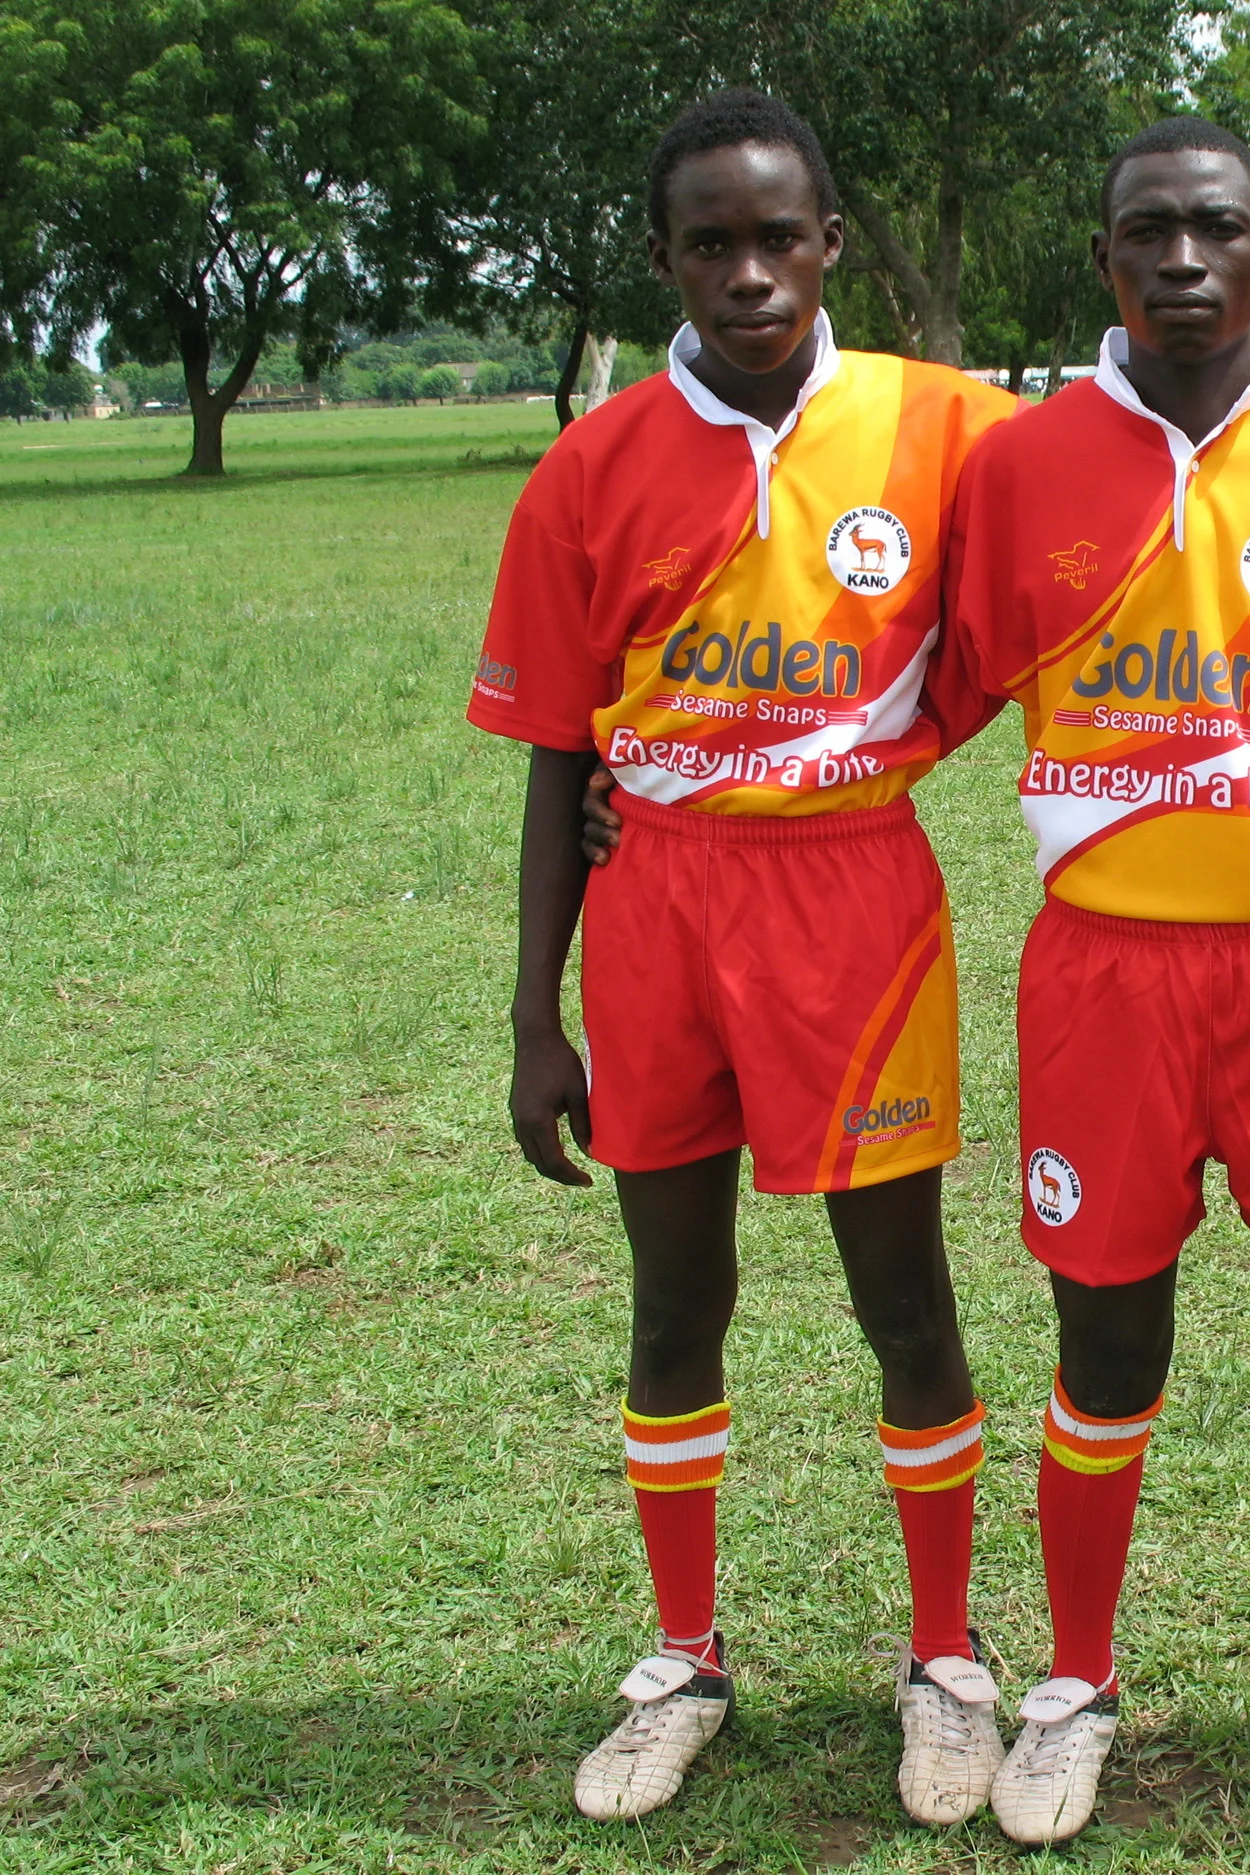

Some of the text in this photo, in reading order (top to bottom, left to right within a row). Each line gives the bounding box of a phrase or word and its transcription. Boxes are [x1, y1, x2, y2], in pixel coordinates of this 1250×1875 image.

[829, 508, 909, 558] BAREWA RUGBY CLUB
[847, 573, 889, 589] KANO
[661, 619, 862, 697] Golden
[670, 690, 827, 725] Sesame Snaps
[1093, 705, 1177, 733] Sesame
[609, 728, 885, 788] Energy in a bite
[1027, 751, 1150, 798] Energy
[1163, 764, 1195, 805] in
[1211, 776, 1232, 808] a
[843, 1097, 930, 1135] Golden
[857, 1132, 894, 1146] Sesame
[1045, 1149, 1070, 1170] RUGBY
[1068, 1172, 1079, 1198] CLUB
[1037, 1203, 1062, 1223] KANO
